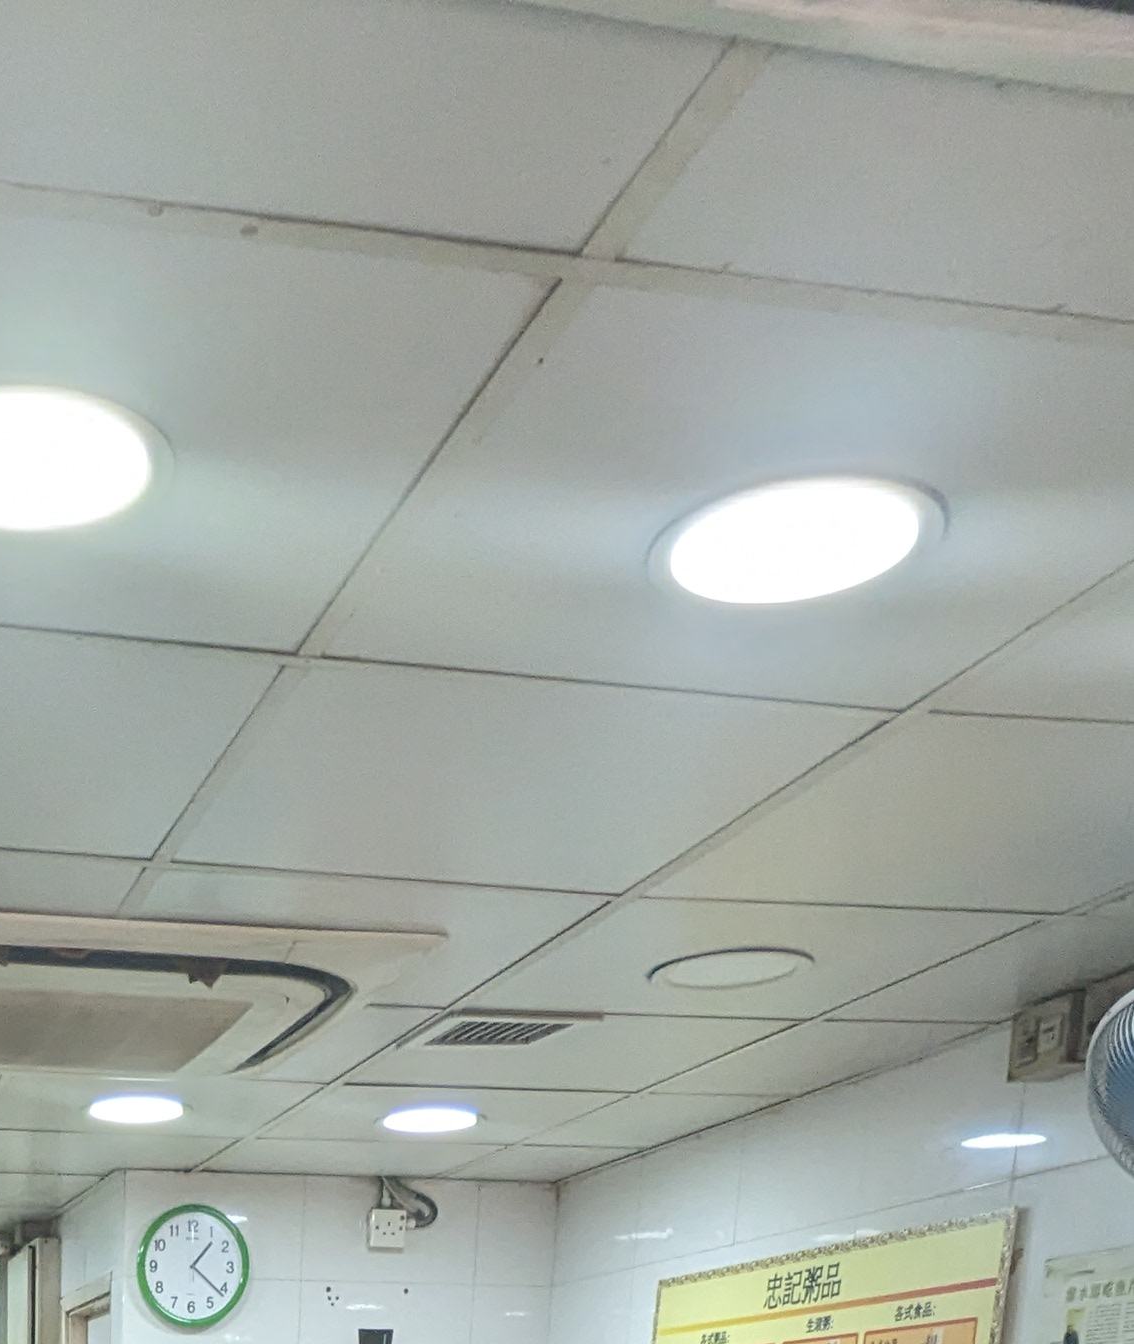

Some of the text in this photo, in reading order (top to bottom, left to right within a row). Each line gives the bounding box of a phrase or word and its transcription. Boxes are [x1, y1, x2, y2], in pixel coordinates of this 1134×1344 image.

[170, 1225, 179, 1237] 11
[188, 1220, 199, 1233] 12
[154, 1239, 166, 1251] 10
[221, 1240, 229, 1253] 2
[149, 1260, 158, 1273] 9
[226, 1261, 234, 1274] 3
[155, 1281, 164, 1294] 8
[220, 1282, 228, 1294] 4
[763, 1262, 842, 1309] 忠記粥品
[170, 1296, 178, 1309] 7
[187, 1301, 195, 1313] 6
[206, 1297, 214, 1309] 5
